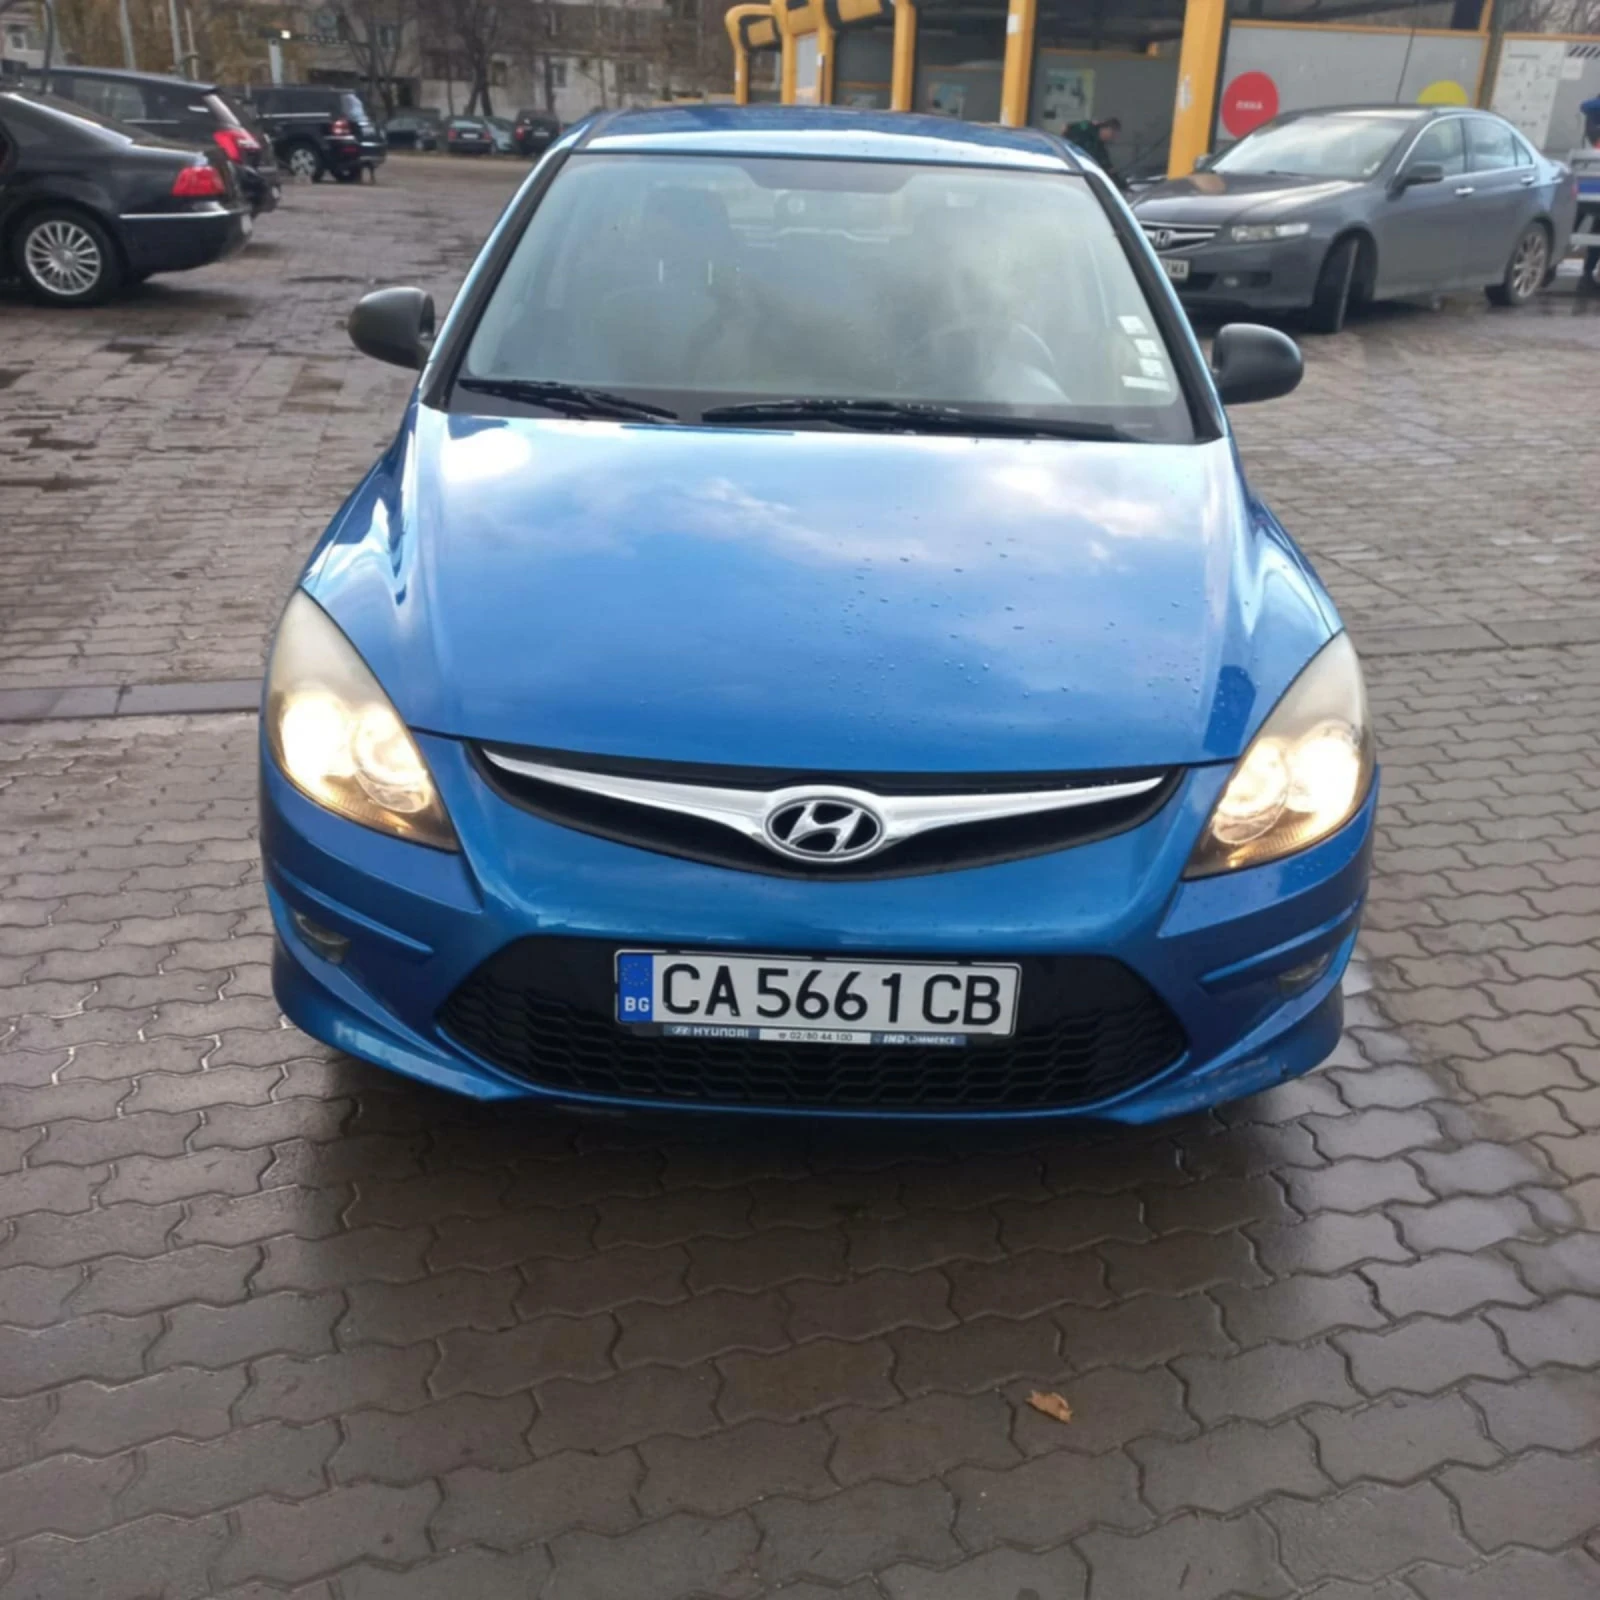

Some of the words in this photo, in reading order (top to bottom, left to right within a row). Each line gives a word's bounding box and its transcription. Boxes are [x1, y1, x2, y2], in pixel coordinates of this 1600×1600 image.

[663, 963, 741, 1017] CA
[757, 967, 902, 1022] 5661
[922, 973, 1002, 1026] CB
[623, 996, 650, 1012] BG
[693, 1026, 749, 1039] HYUNDAI
